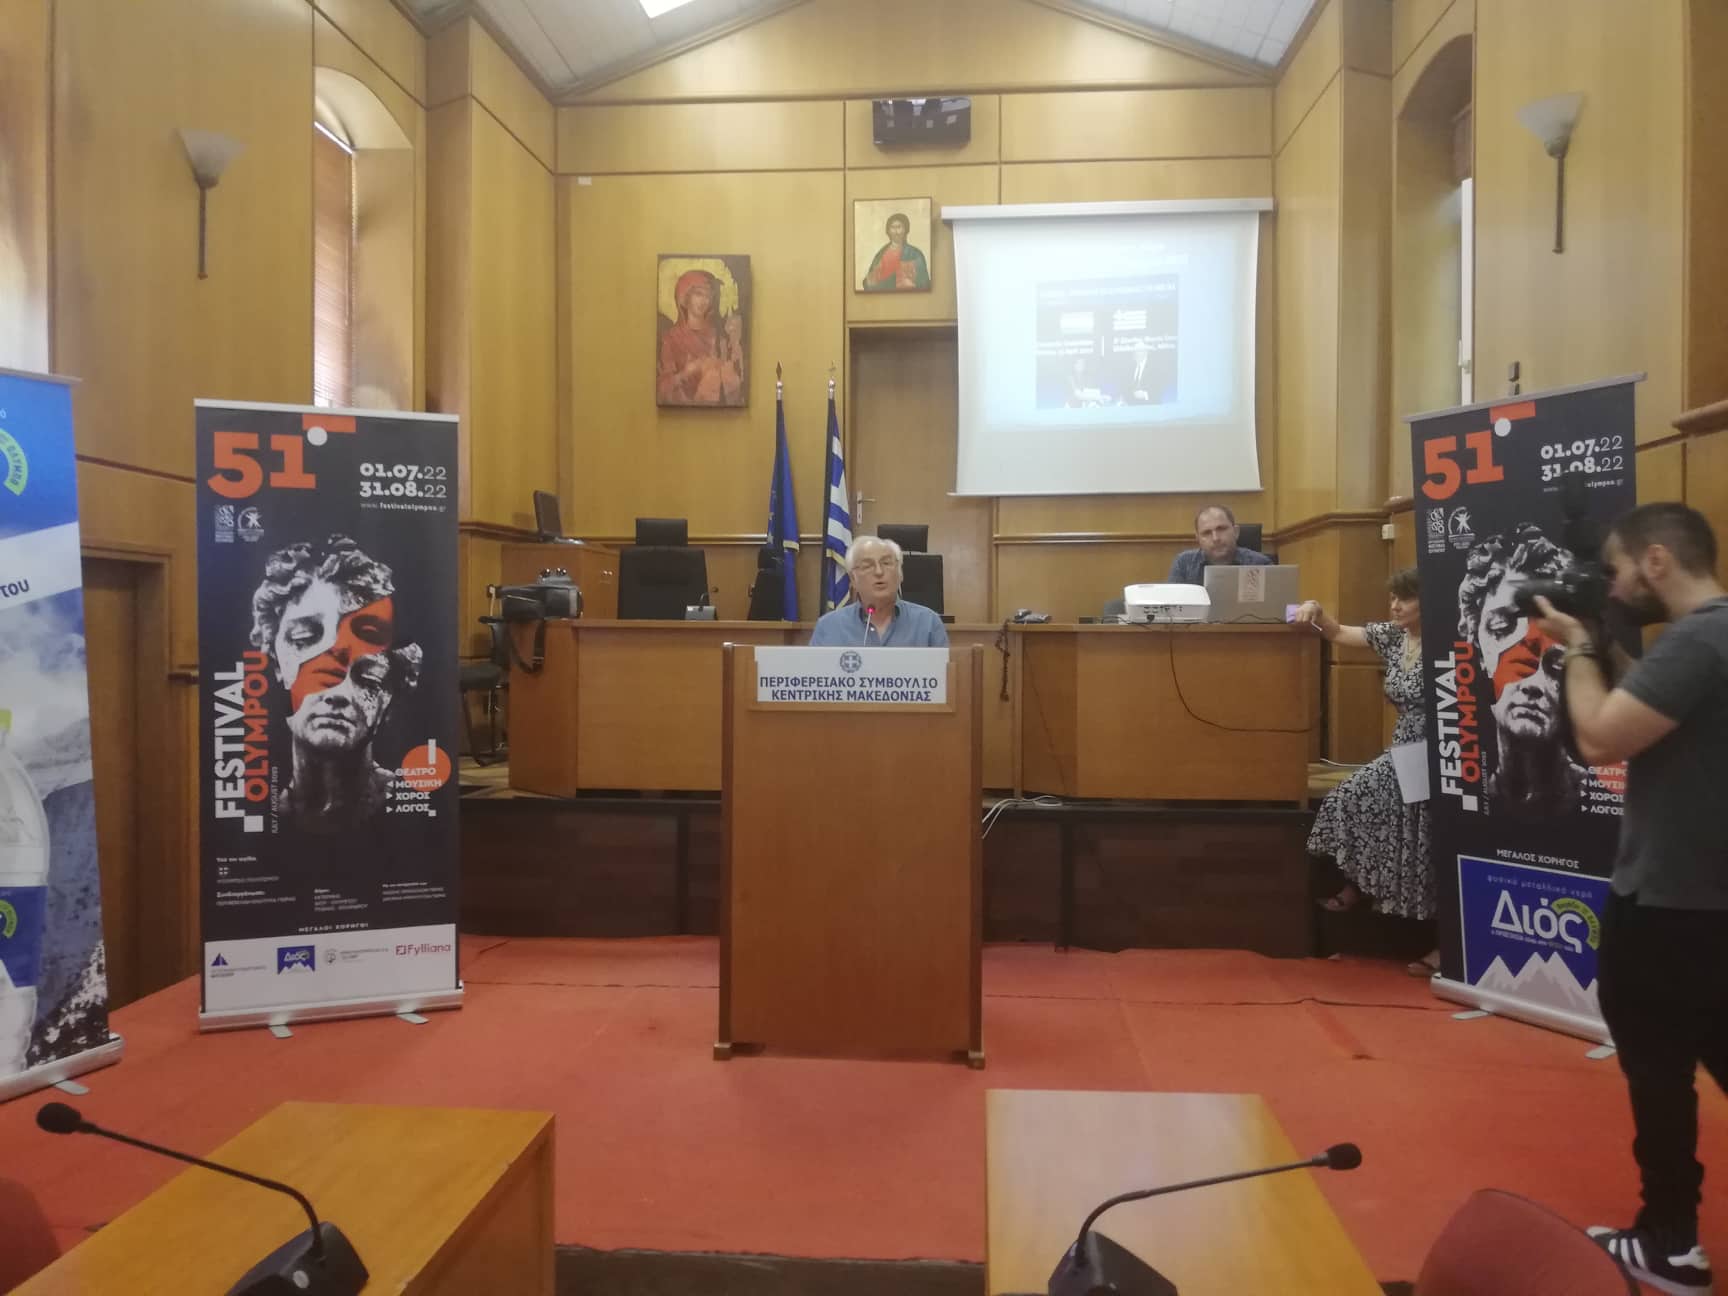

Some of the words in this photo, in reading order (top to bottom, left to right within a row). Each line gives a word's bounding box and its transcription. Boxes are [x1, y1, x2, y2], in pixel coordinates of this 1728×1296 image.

[1541, 435, 1623, 459] 01.07.22
[360, 462, 447, 480] 01.07.22
[360, 481, 447, 498] 31.08.22
[760, 676, 855, 688] ΠΕΡΙΦΕΡΕΙΑΚΟ
[858, 677, 938, 689] ΣΥΜΒΟΥΛΙΟ
[772, 689, 843, 701] ΚΕΝΤΡΙΚΗΣ
[847, 690, 931, 702] ΜΑΚΕΔΟΝΙΑΣ
[1455, 641, 1480, 783] OLYMPOU
[243, 651, 269, 802] OLYMPOU
[1434, 651, 1463, 795] FESTIVAL
[214, 661, 245, 818] FESTIVAL
[395, 791, 431, 800] ΧΟΡΟΣ
[395, 803, 430, 812] ΛΟΓΟΣ
[1491, 889, 1583, 954] Διός
[407, 944, 451, 956] Fylliana
